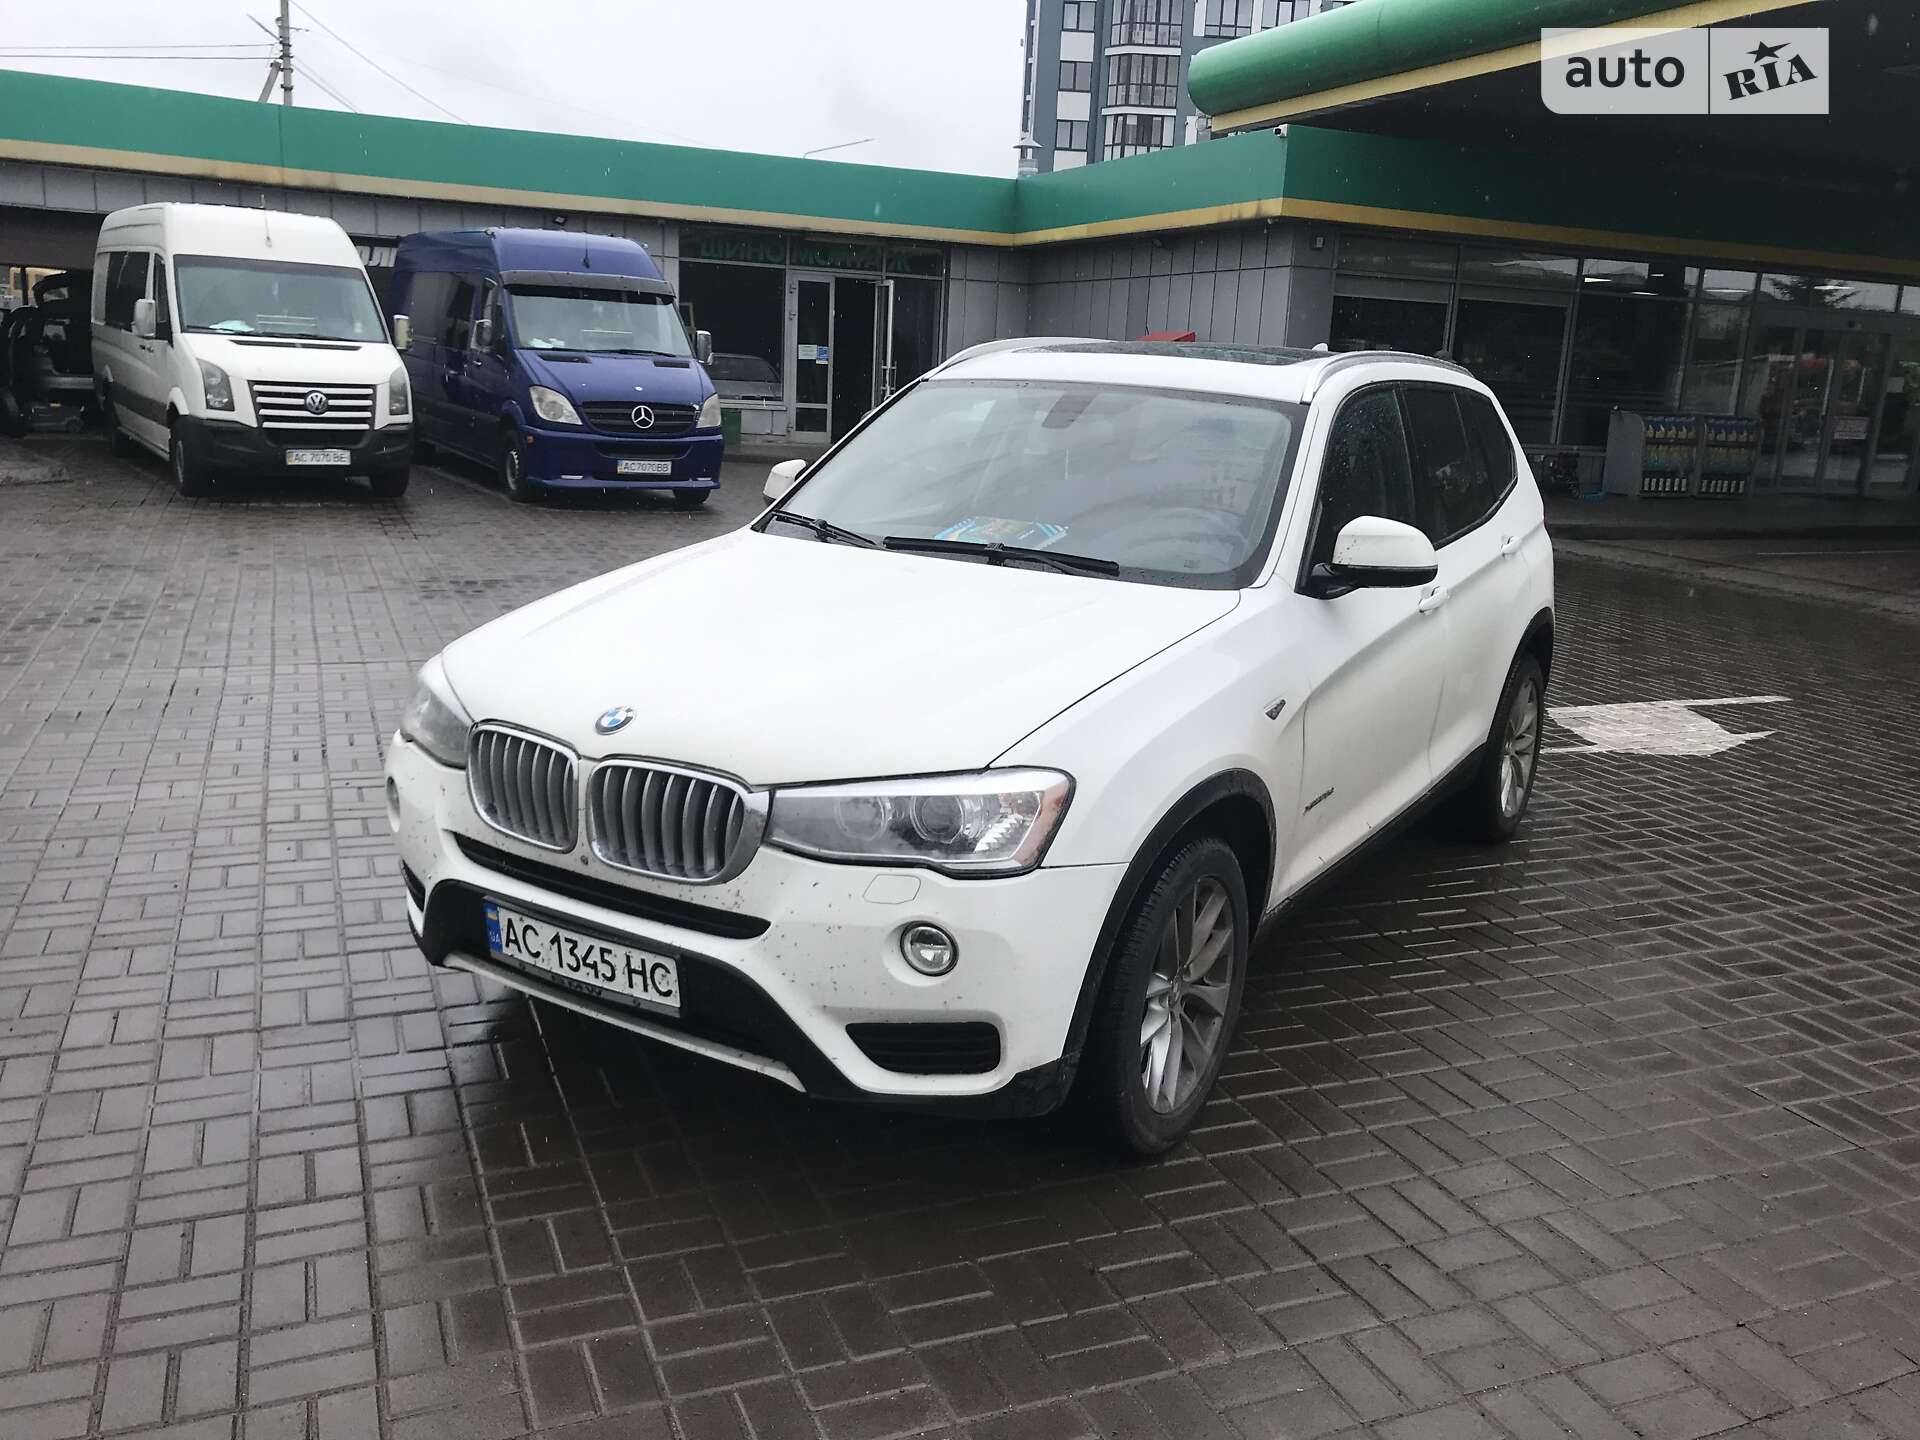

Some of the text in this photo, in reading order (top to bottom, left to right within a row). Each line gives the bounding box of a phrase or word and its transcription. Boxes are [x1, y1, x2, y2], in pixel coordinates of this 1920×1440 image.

[505, 918, 541, 959] AC
[550, 932, 616, 983] 1345
[624, 951, 673, 997] HC
